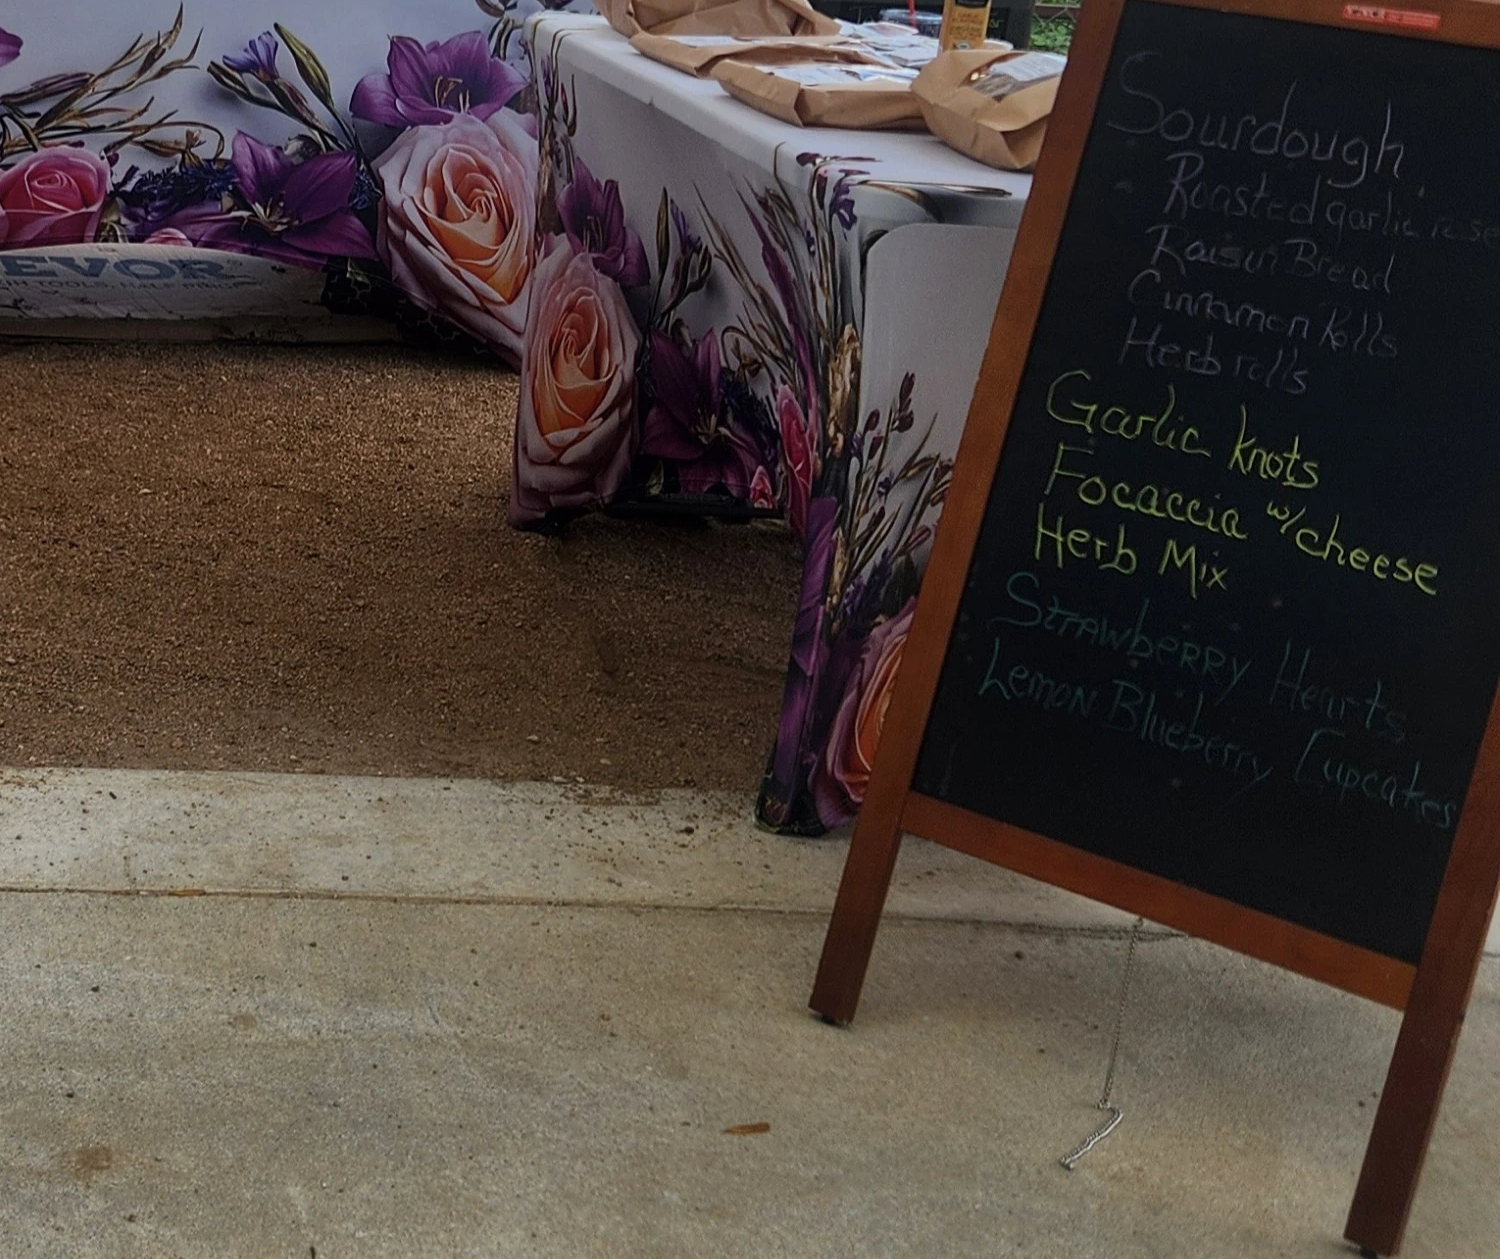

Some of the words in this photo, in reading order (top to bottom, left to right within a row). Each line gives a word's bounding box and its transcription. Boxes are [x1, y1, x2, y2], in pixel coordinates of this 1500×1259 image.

[1107, 51, 1404, 188] Sourdough
[1284, 239, 1395, 295] Bread
[1117, 317, 1222, 375] Herb
[1045, 370, 1210, 458] Garlic
[1044, 442, 1248, 539] Focaccia
[1034, 502, 1137, 575] Herb
